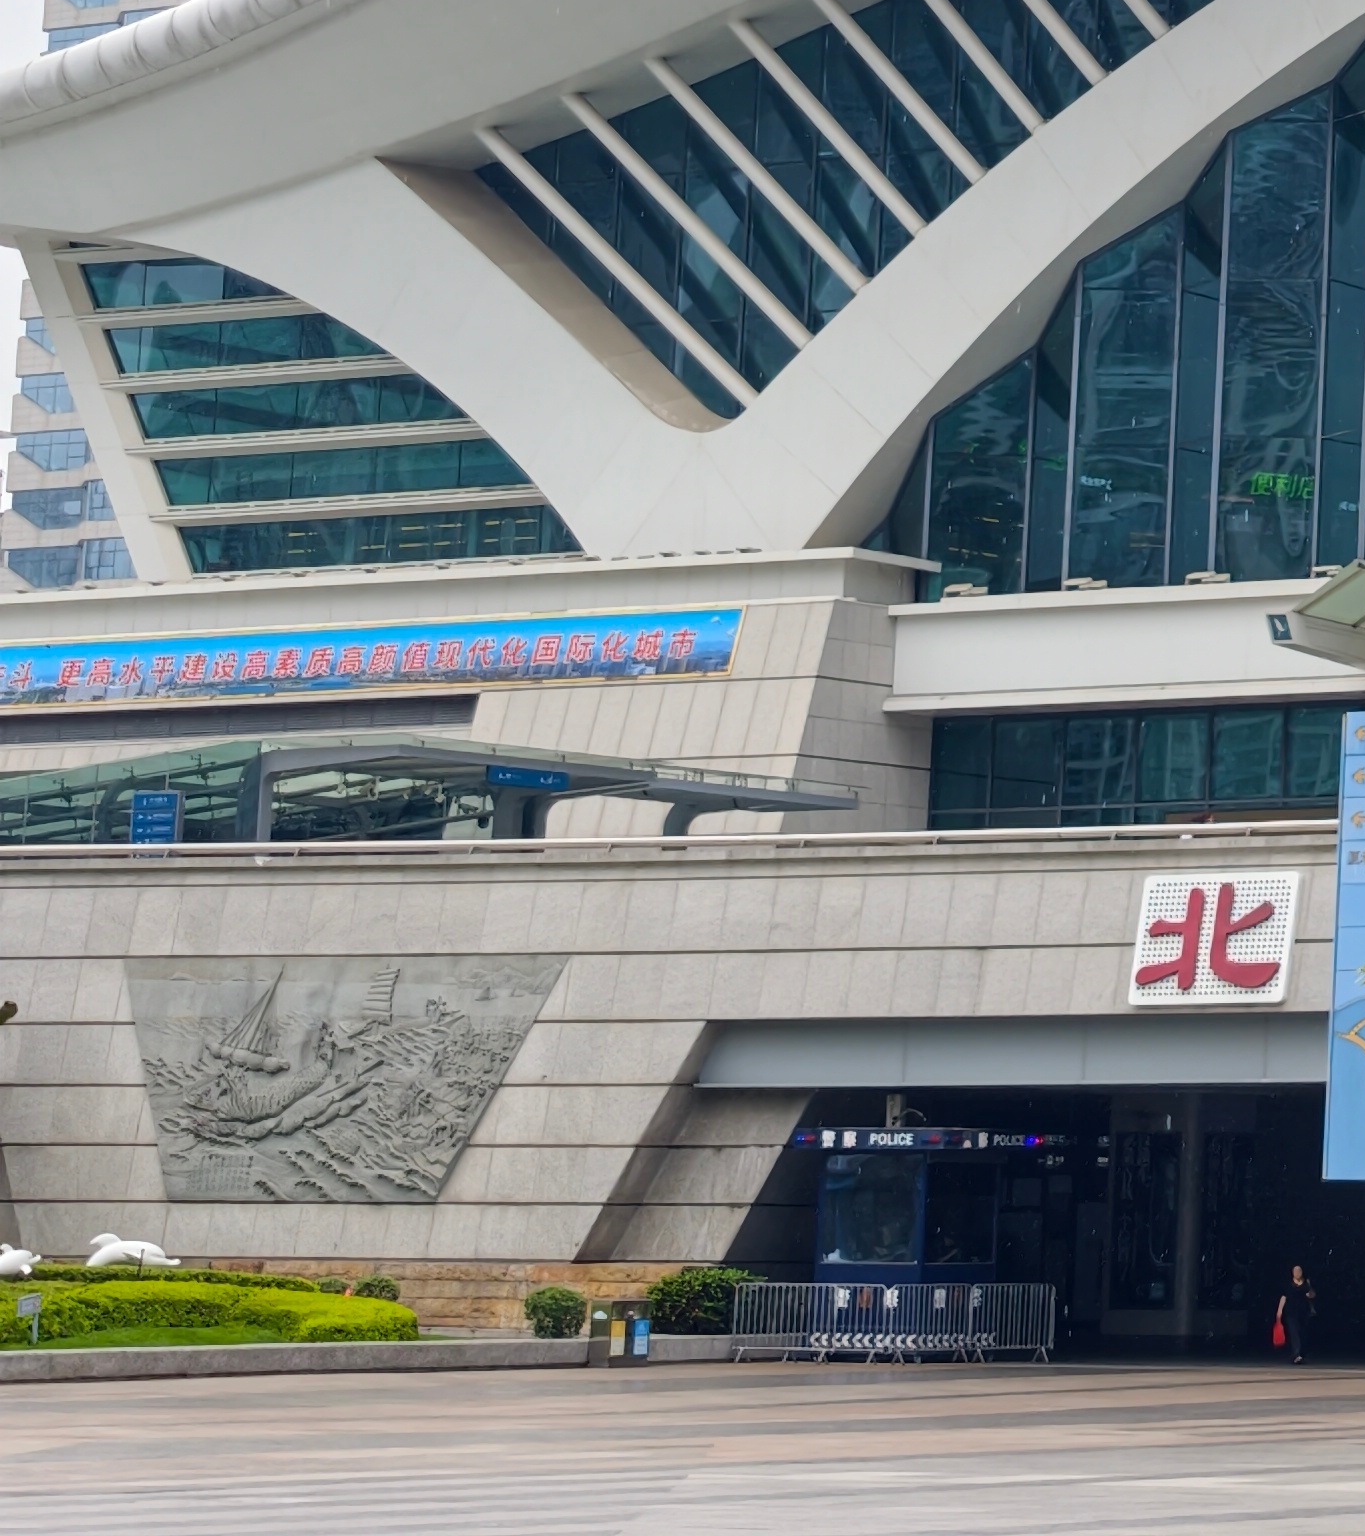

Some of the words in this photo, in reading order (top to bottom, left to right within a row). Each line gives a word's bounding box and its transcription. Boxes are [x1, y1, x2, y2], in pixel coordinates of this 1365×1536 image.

[0, 659, 33, 691] 斗
[1135, 882, 1281, 990] 北
[869, 1132, 914, 1146] POLICE
